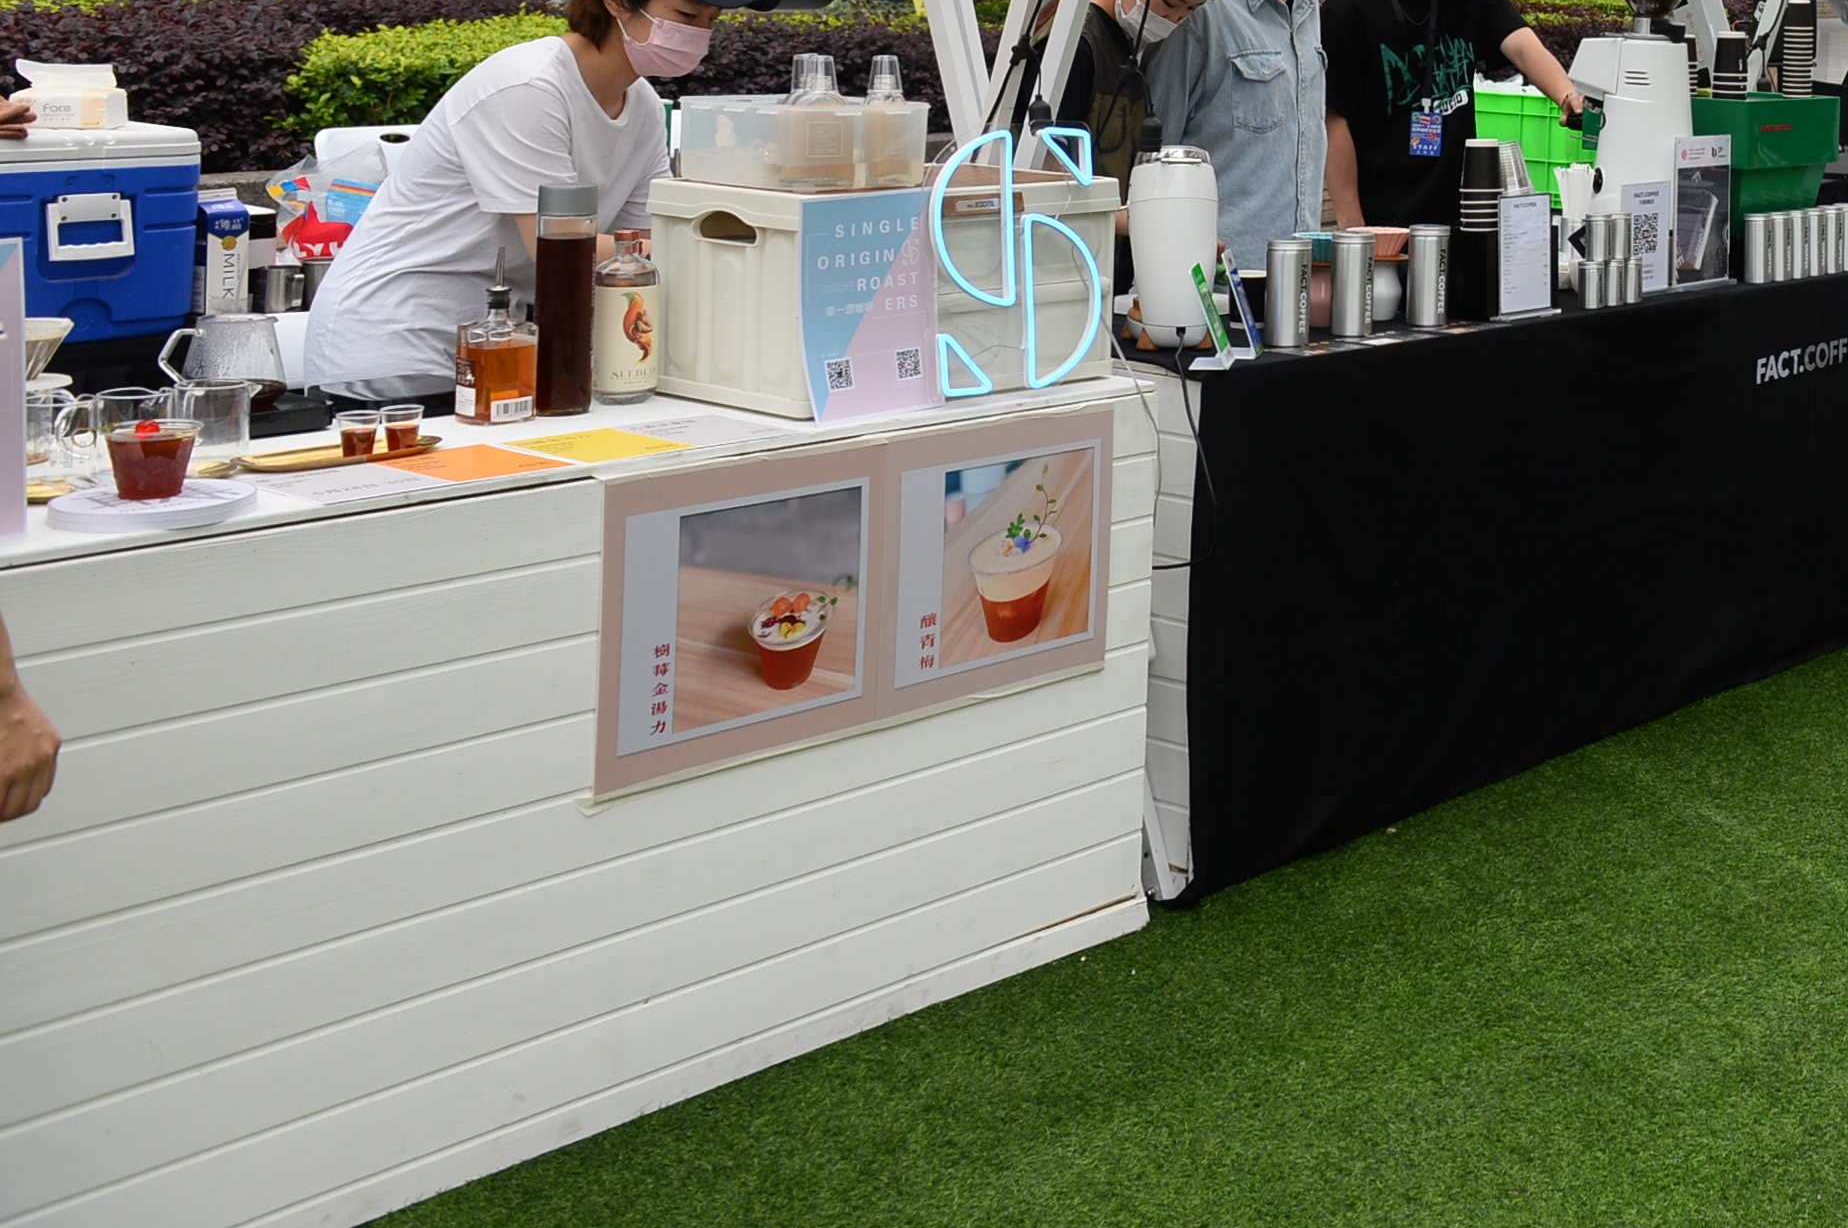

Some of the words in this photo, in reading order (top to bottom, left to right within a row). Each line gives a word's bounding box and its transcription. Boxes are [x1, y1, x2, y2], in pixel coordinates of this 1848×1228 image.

[43, 103, 71, 113] Face
[835, 217, 919, 238] SINGLE
[817, 248, 895, 270] ORIGIN
[222, 253, 236, 299] MILK
[857, 272, 918, 291] ROAST
[1436, 249, 1447, 314] FACT.COFFEE
[1299, 264, 1308, 334] FACT.COFFEE
[1364, 256, 1373, 324] FACT.COFFEE
[885, 295, 918, 310] ERS
